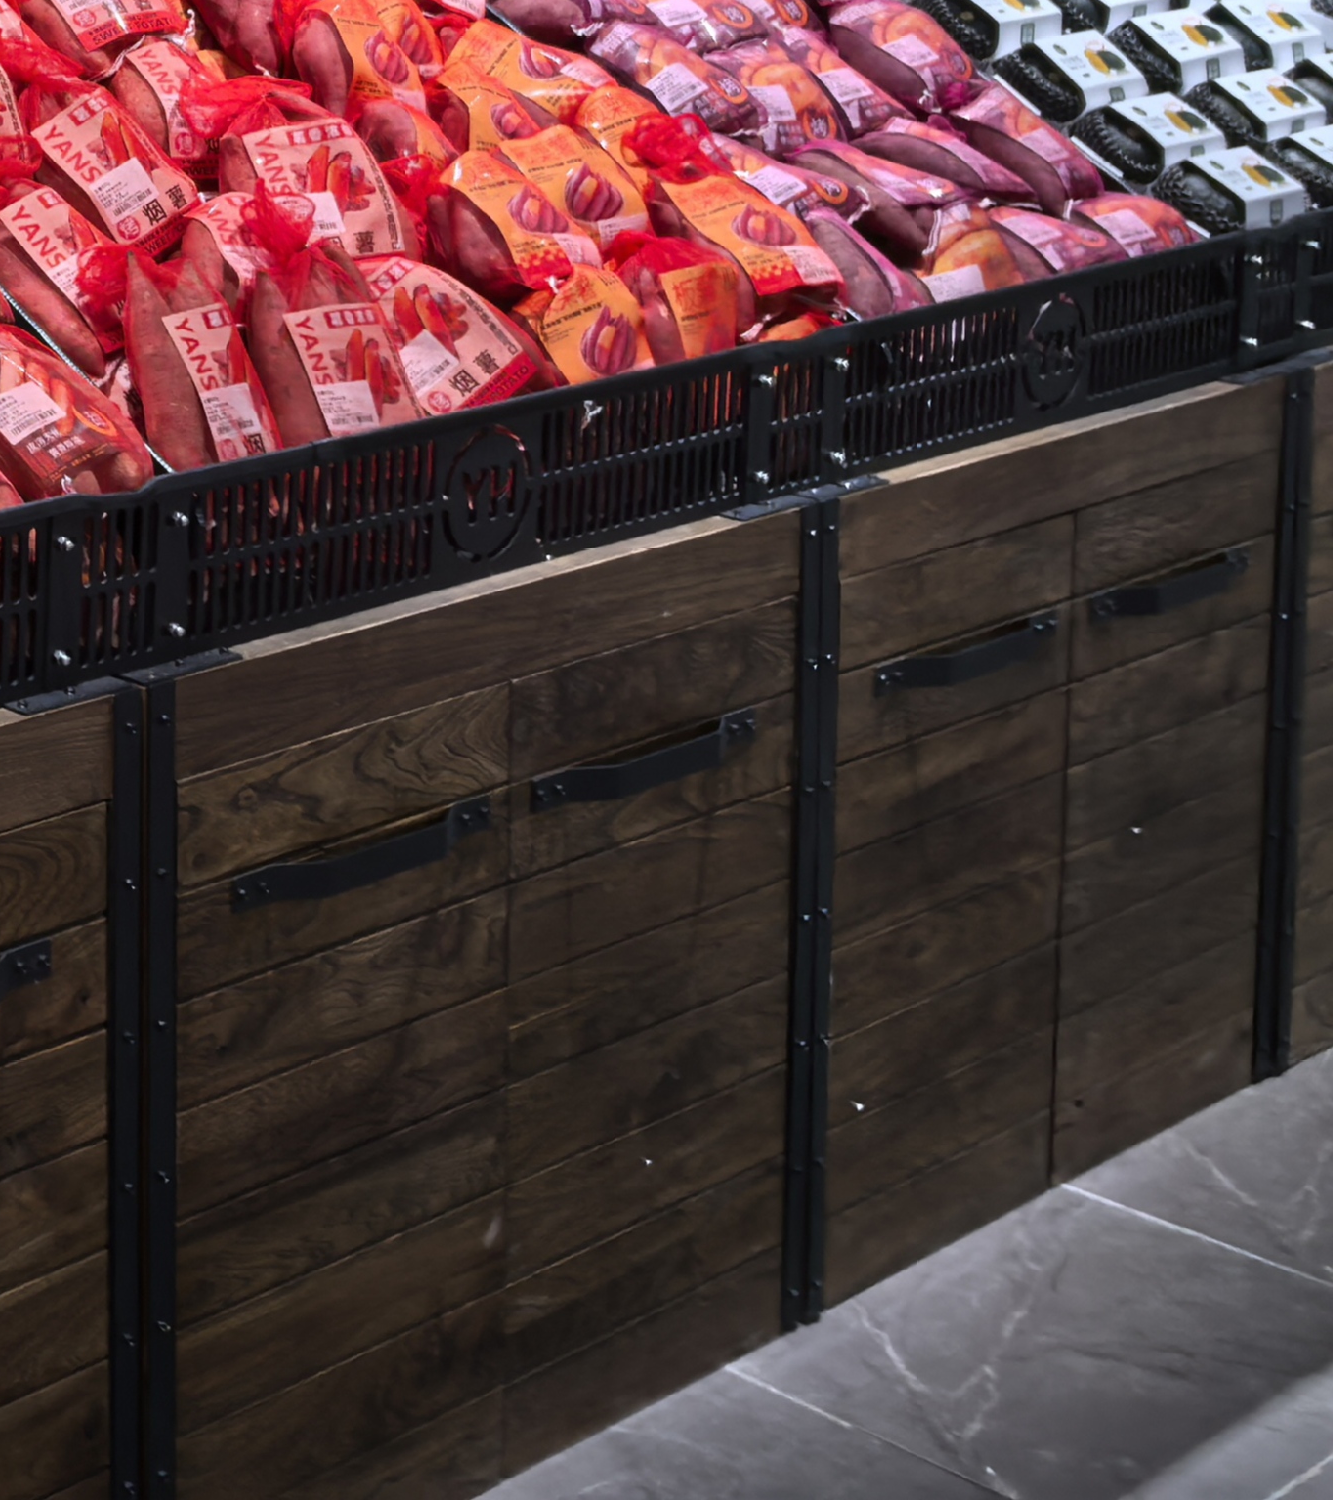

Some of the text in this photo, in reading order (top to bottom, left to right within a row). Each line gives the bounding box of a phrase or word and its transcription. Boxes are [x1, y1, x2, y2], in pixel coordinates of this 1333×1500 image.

[43, 124, 104, 184] YANS
[9, 202, 66, 269] YANS
[174, 317, 219, 390] YANS
[295, 316, 333, 386] YANS
